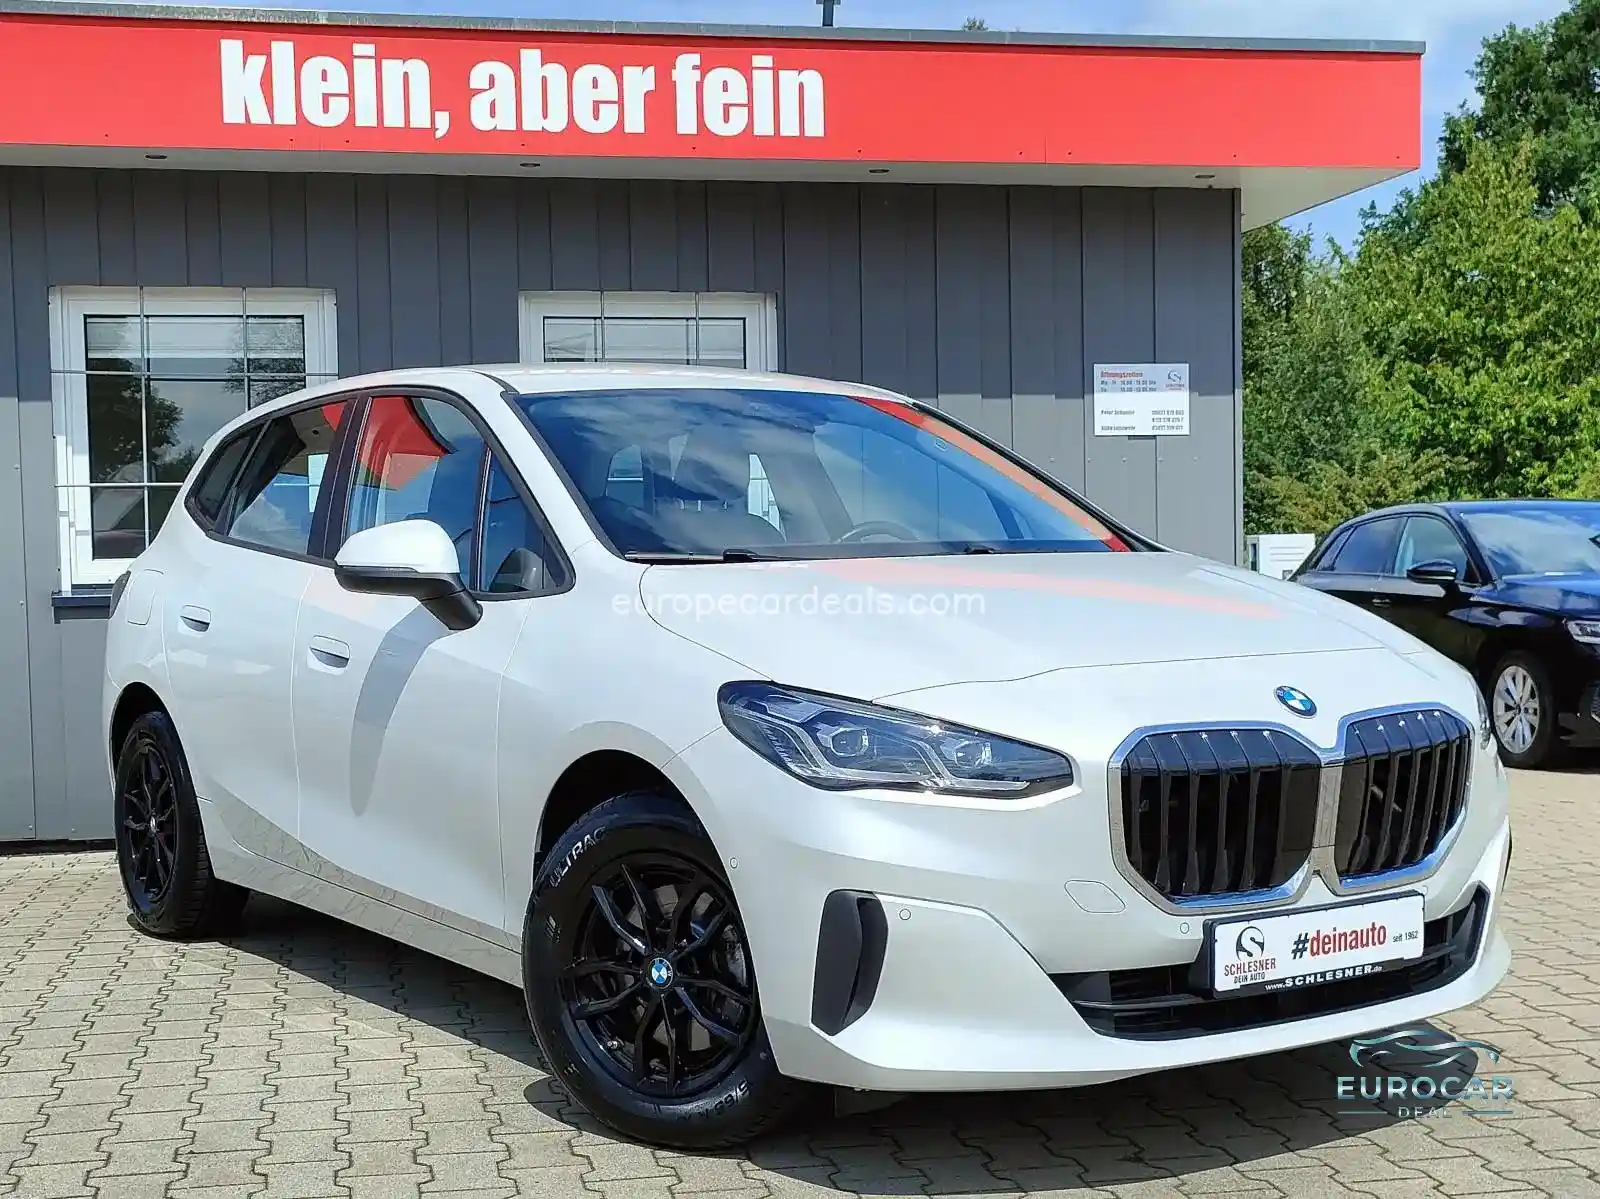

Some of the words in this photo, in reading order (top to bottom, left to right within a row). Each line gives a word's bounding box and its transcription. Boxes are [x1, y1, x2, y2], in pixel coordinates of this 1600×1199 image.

[220, 39, 450, 138] klein,
[469, 48, 656, 134] aber
[672, 52, 826, 138] fein
[1290, 922, 1387, 960] #deinauto
[1224, 957, 1277, 977] SCHLESNER
[1233, 974, 1249, 985] DEIN
[1249, 971, 1267, 983] AUTO
[1265, 964, 1383, 991] www.SCHLESNER.de
